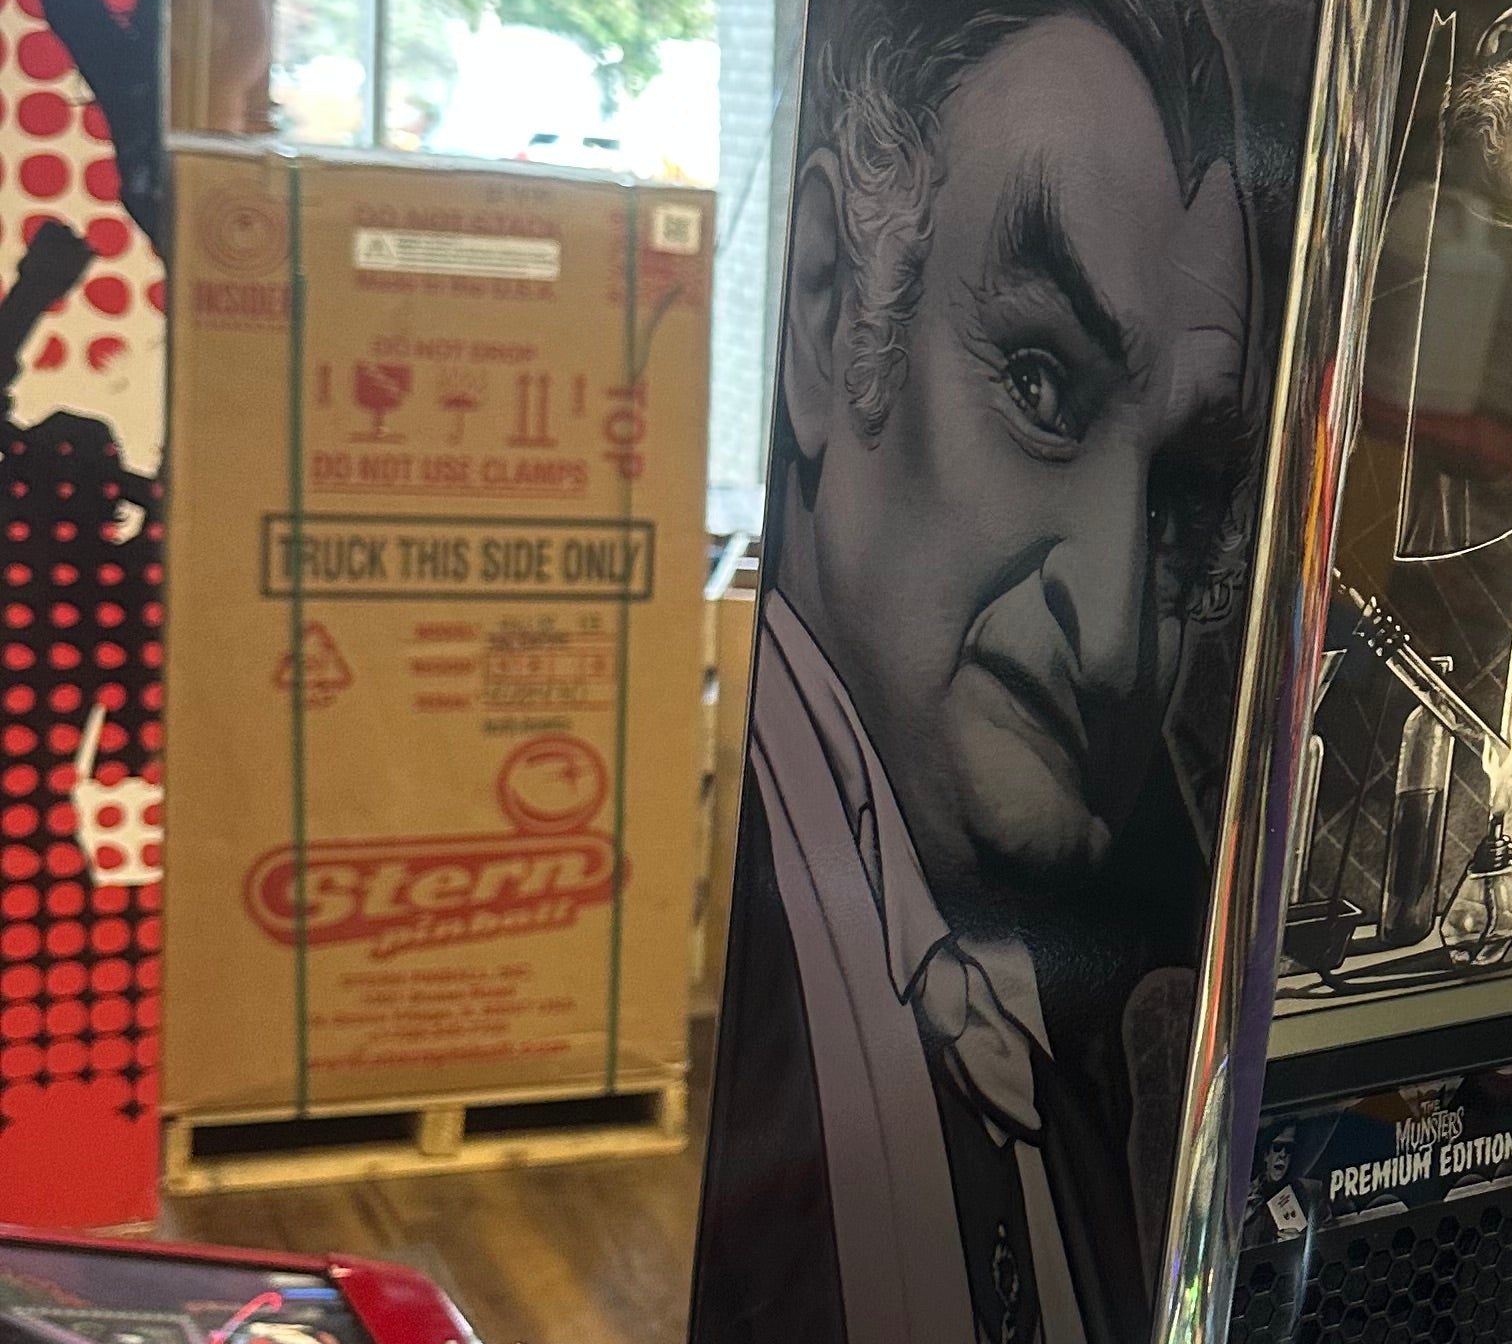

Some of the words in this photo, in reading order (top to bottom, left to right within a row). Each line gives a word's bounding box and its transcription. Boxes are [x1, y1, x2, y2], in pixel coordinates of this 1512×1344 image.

[311, 452, 351, 482] DO
[359, 453, 412, 483] NOT
[422, 455, 470, 485] USE
[479, 457, 588, 490] CLAMPS
[398, 535, 470, 582] THIS
[480, 538, 553, 584] SIDE
[562, 538, 642, 585] ONLY
[289, 851, 588, 928] Stern
[1395, 1106, 1465, 1157] MUNSTERS
[1329, 1151, 1432, 1202] PREMIUM
